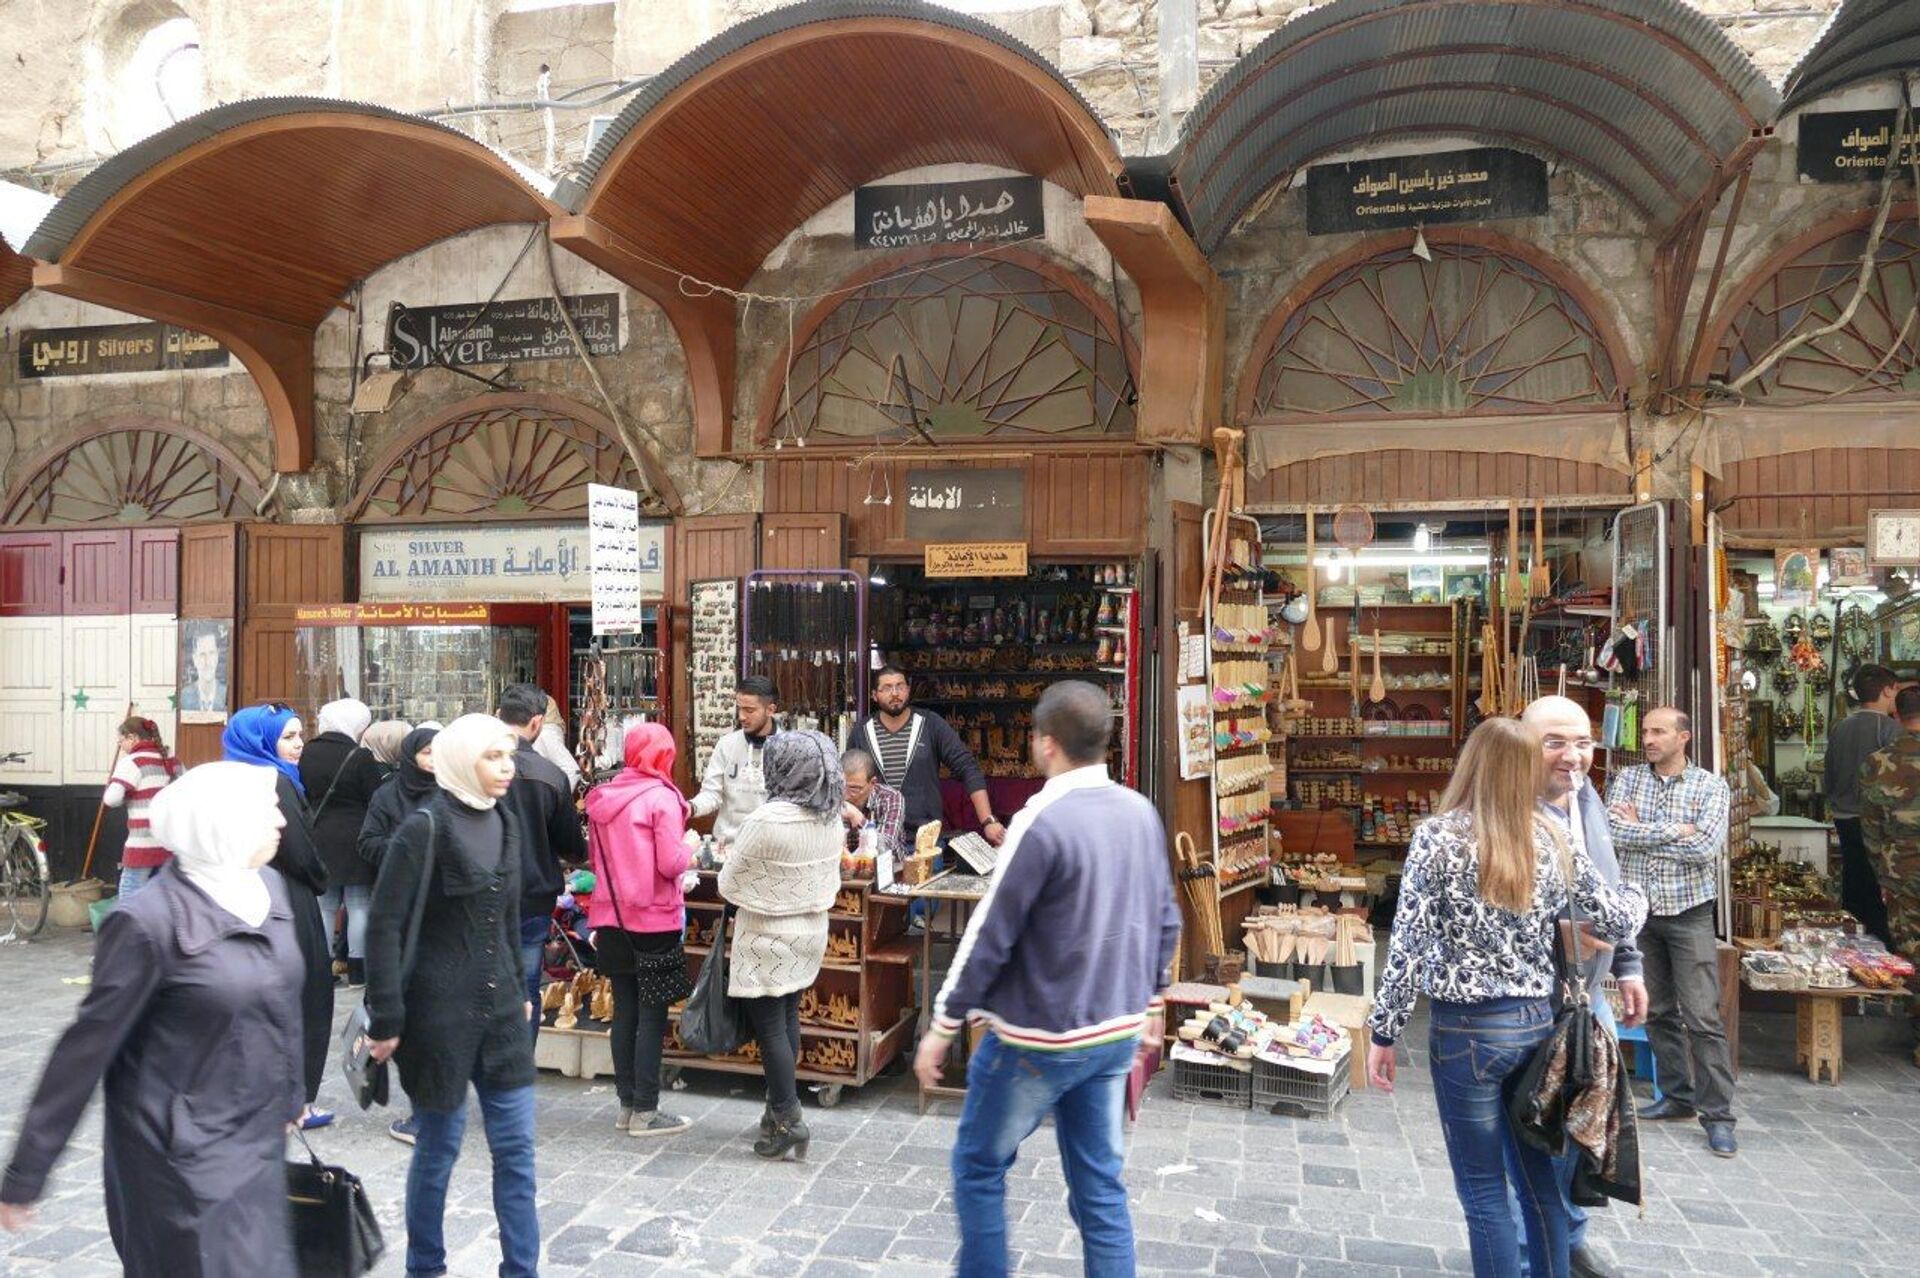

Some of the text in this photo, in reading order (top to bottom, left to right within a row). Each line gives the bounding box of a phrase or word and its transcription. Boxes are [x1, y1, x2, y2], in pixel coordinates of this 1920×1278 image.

[1834, 155, 1890, 168] Orienta
[1353, 172, 1397, 197] الصواف
[1400, 169, 1434, 194] ياسين
[1457, 170, 1489, 184] محمد
[1355, 203, 1406, 217] Orientals
[98, 338, 154, 357] Silvers
[408, 541, 465, 555] SILVER
[944, 548, 1009, 564] هدايا الأمانة
[373, 558, 496, 577] AL AMANIH
[502, 536, 578, 581] الأمانة
[356, 603, 488, 624] فضيات الأمانة
